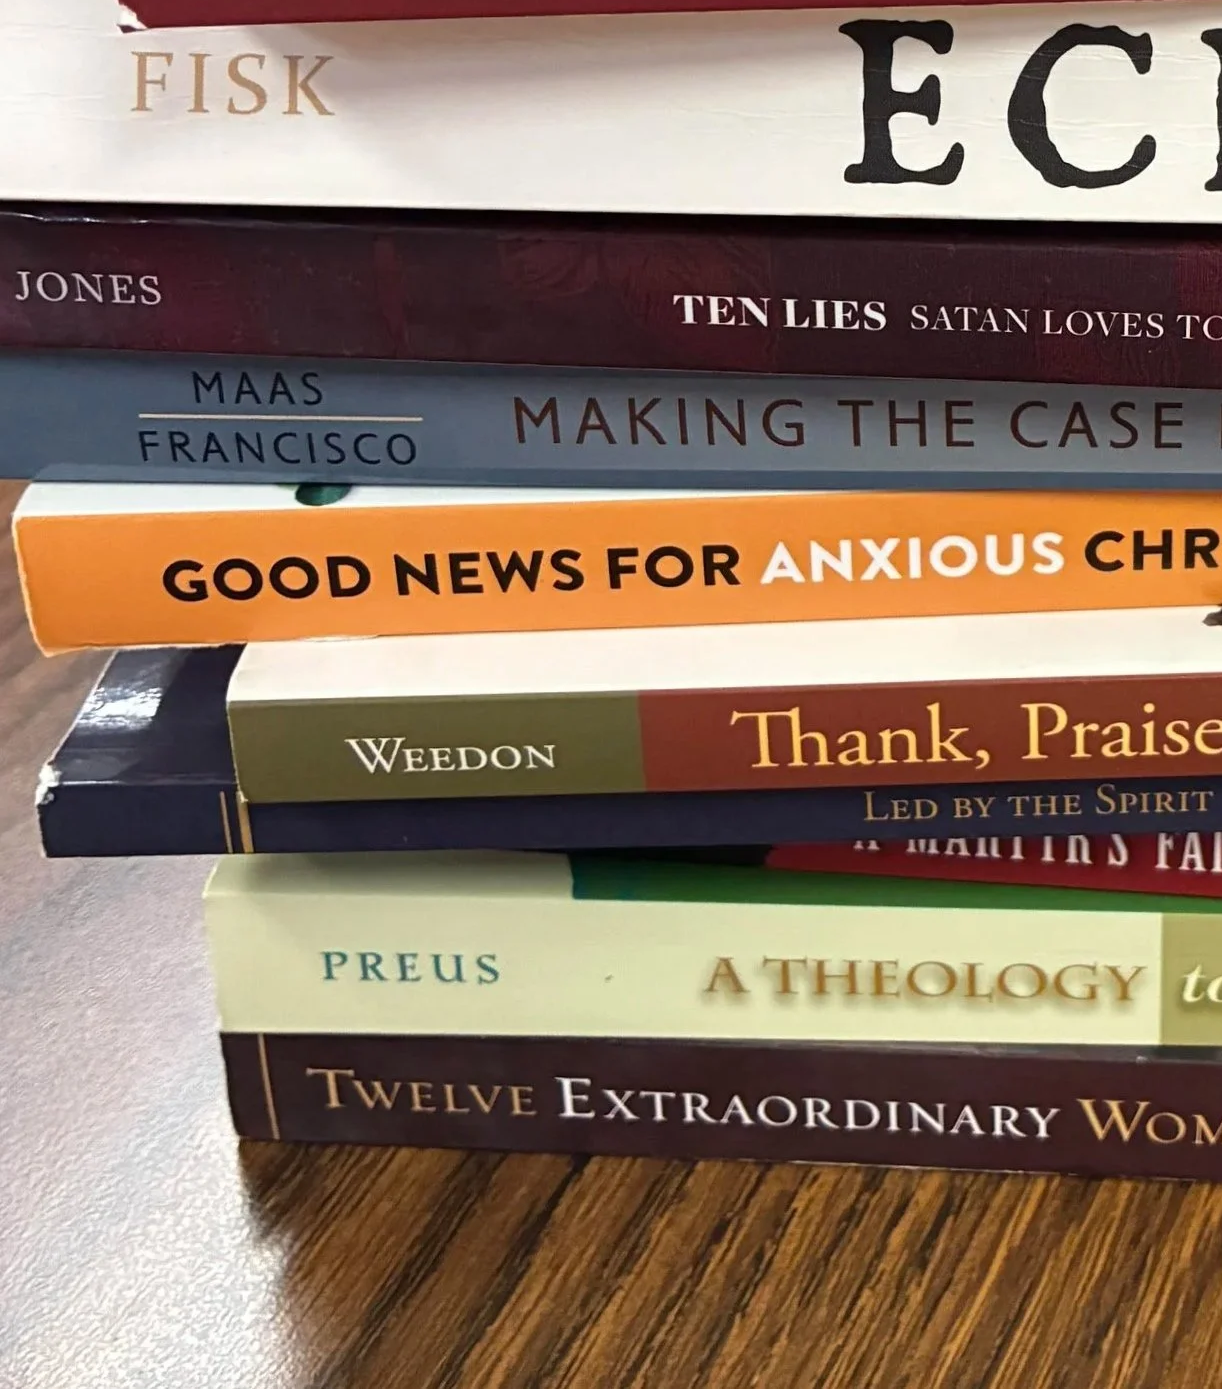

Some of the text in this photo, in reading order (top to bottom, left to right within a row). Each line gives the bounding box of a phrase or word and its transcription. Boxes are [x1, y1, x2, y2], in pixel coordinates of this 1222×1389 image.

[131, 51, 336, 117] FISK
[14, 269, 163, 307] JONES
[672, 293, 773, 328] TEN
[783, 298, 888, 333] LIES
[910, 303, 1031, 336] SATAN
[1042, 309, 1166, 341] LOVES
[190, 369, 325, 408] MAAS
[512, 395, 808, 449] MAKING
[838, 399, 977, 449] THE
[1009, 401, 1185, 451] CASE
[137, 429, 419, 469] FRANCISCO
[161, 553, 372, 603] GOOD
[393, 549, 587, 597] NEWS
[607, 542, 742, 591] FOR
[759, 531, 1066, 585] ANXIOUS
[730, 703, 992, 771] Thank,
[951, 789, 998, 821] BY
[1005, 791, 1083, 821] THE
[318, 949, 502, 986] PREUS
[703, 955, 748, 995] A
[760, 955, 1146, 1003] THEOLOGY
